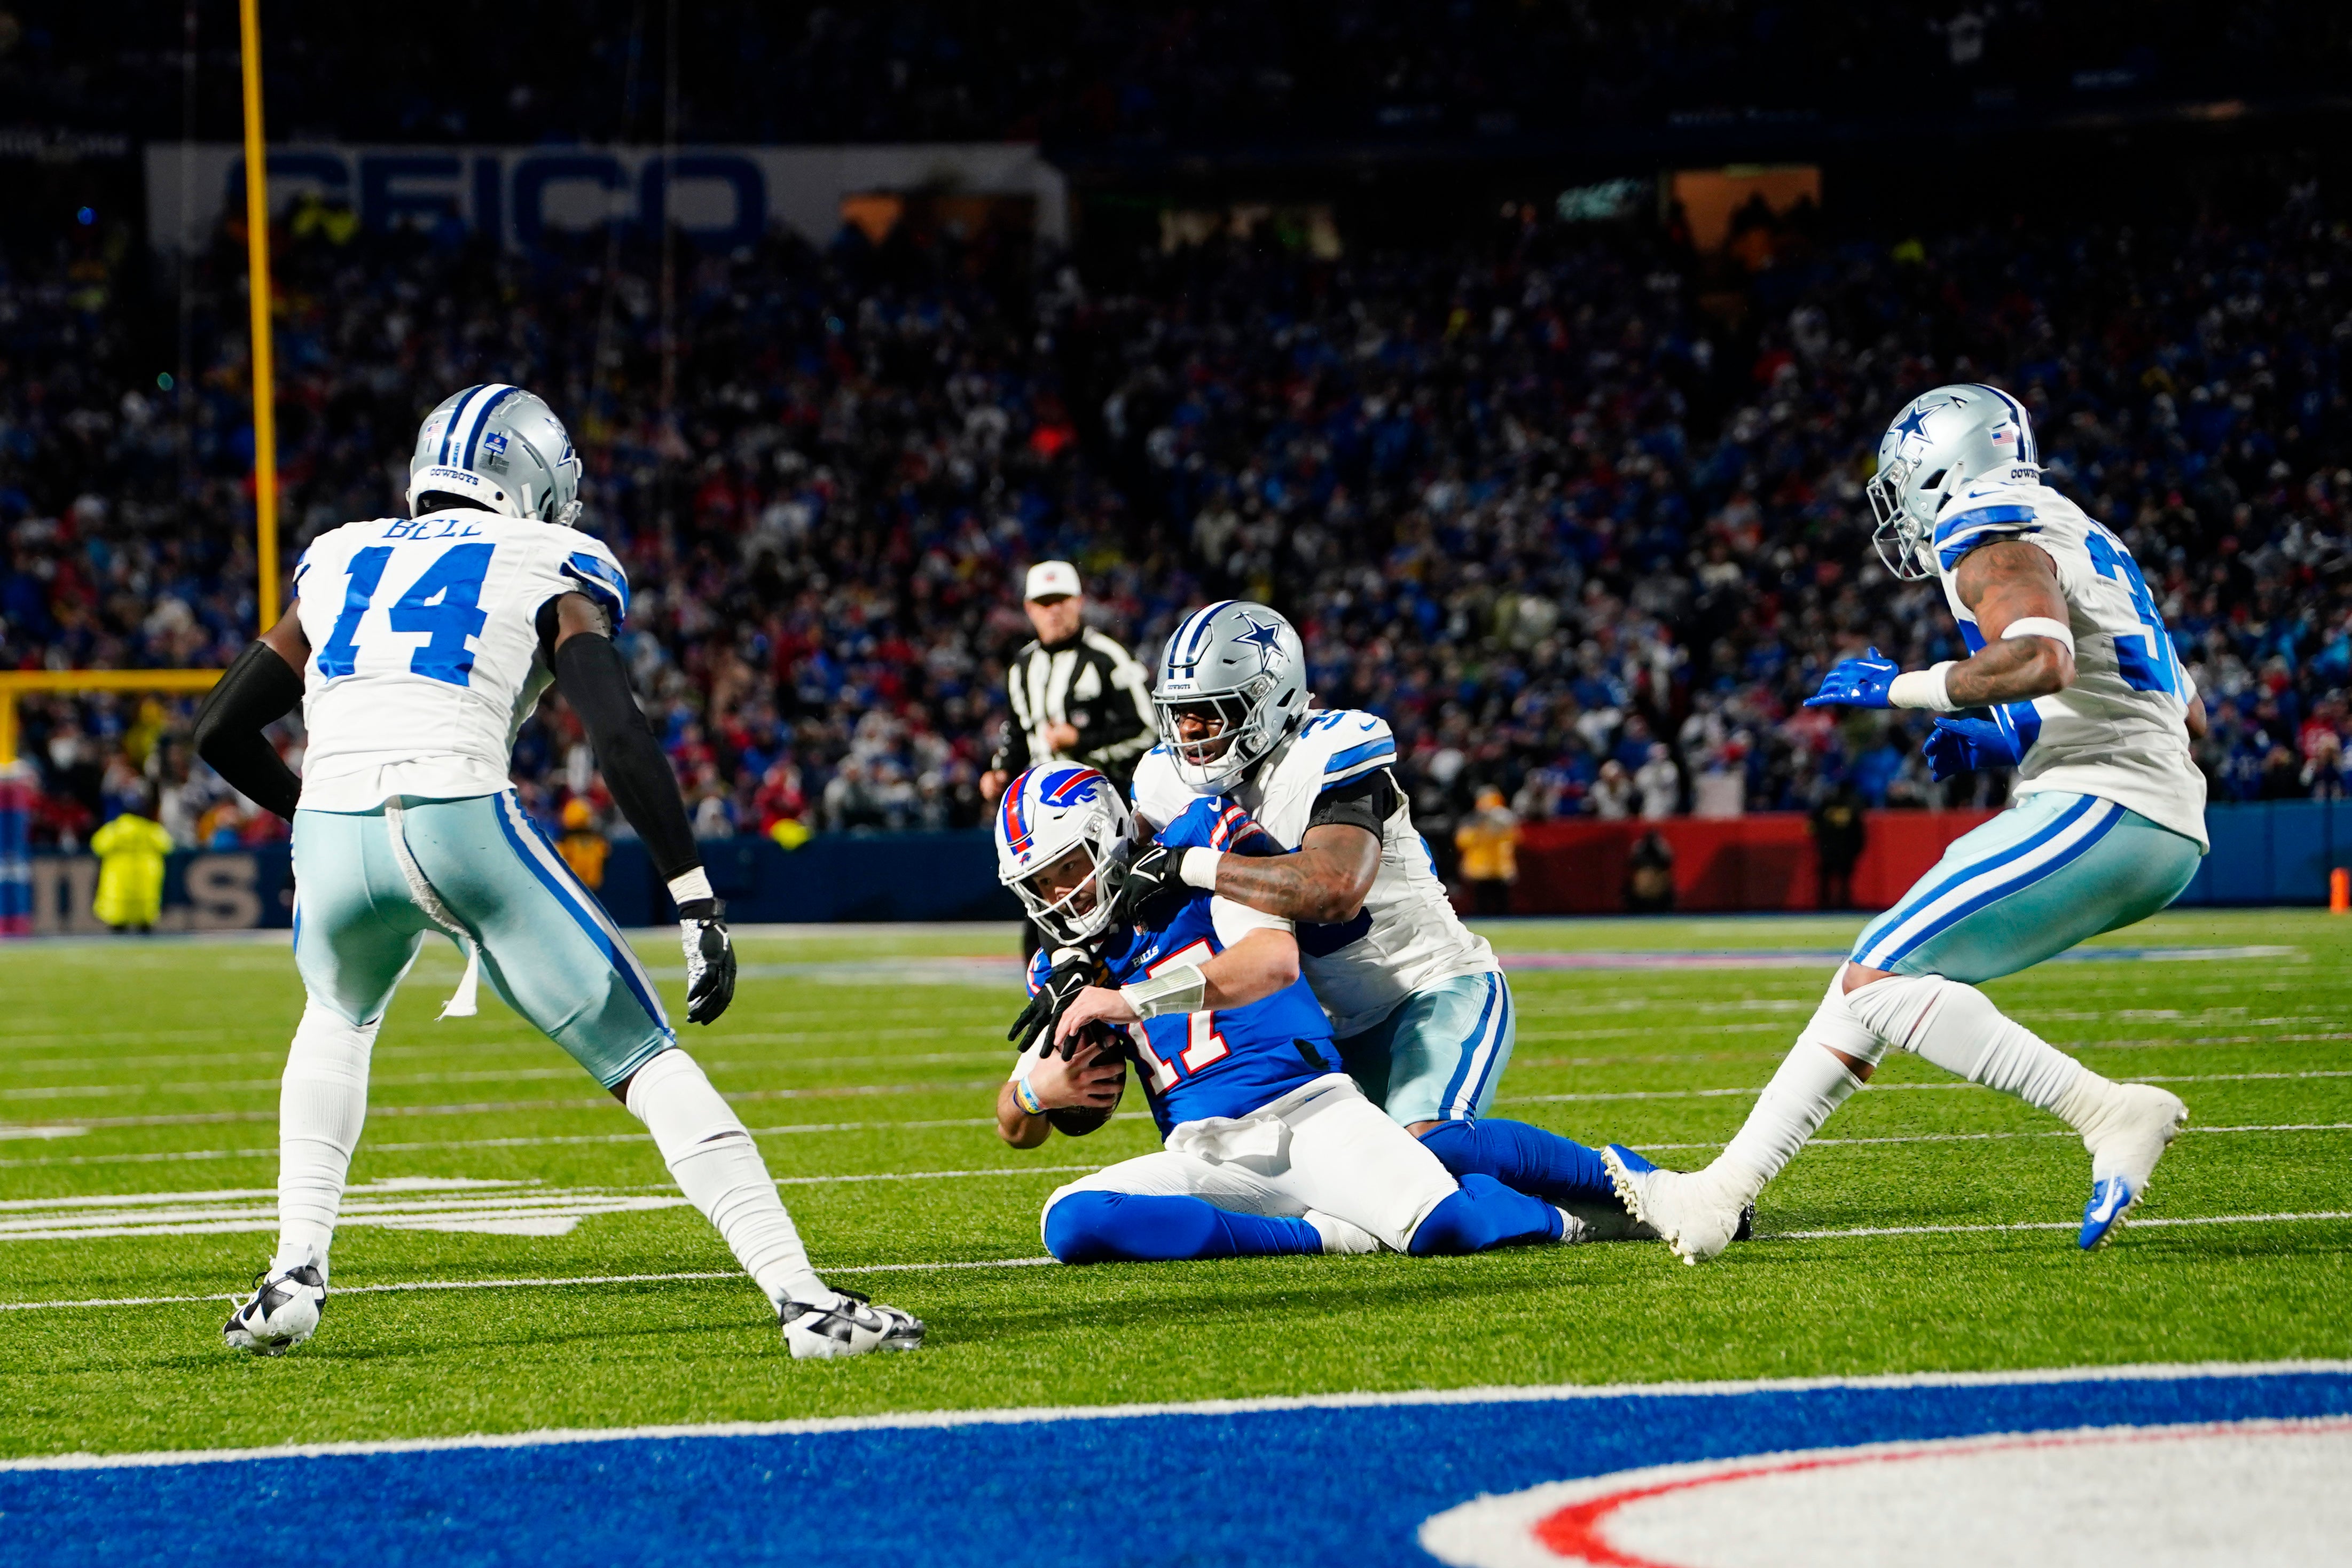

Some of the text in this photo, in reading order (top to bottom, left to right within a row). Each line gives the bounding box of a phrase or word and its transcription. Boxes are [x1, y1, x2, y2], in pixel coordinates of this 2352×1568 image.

[430, 469, 479, 485] COWBOYS
[382, 518, 483, 540] BELL
[318, 543, 497, 687] 14
[1132, 945, 1159, 968] BILLS
